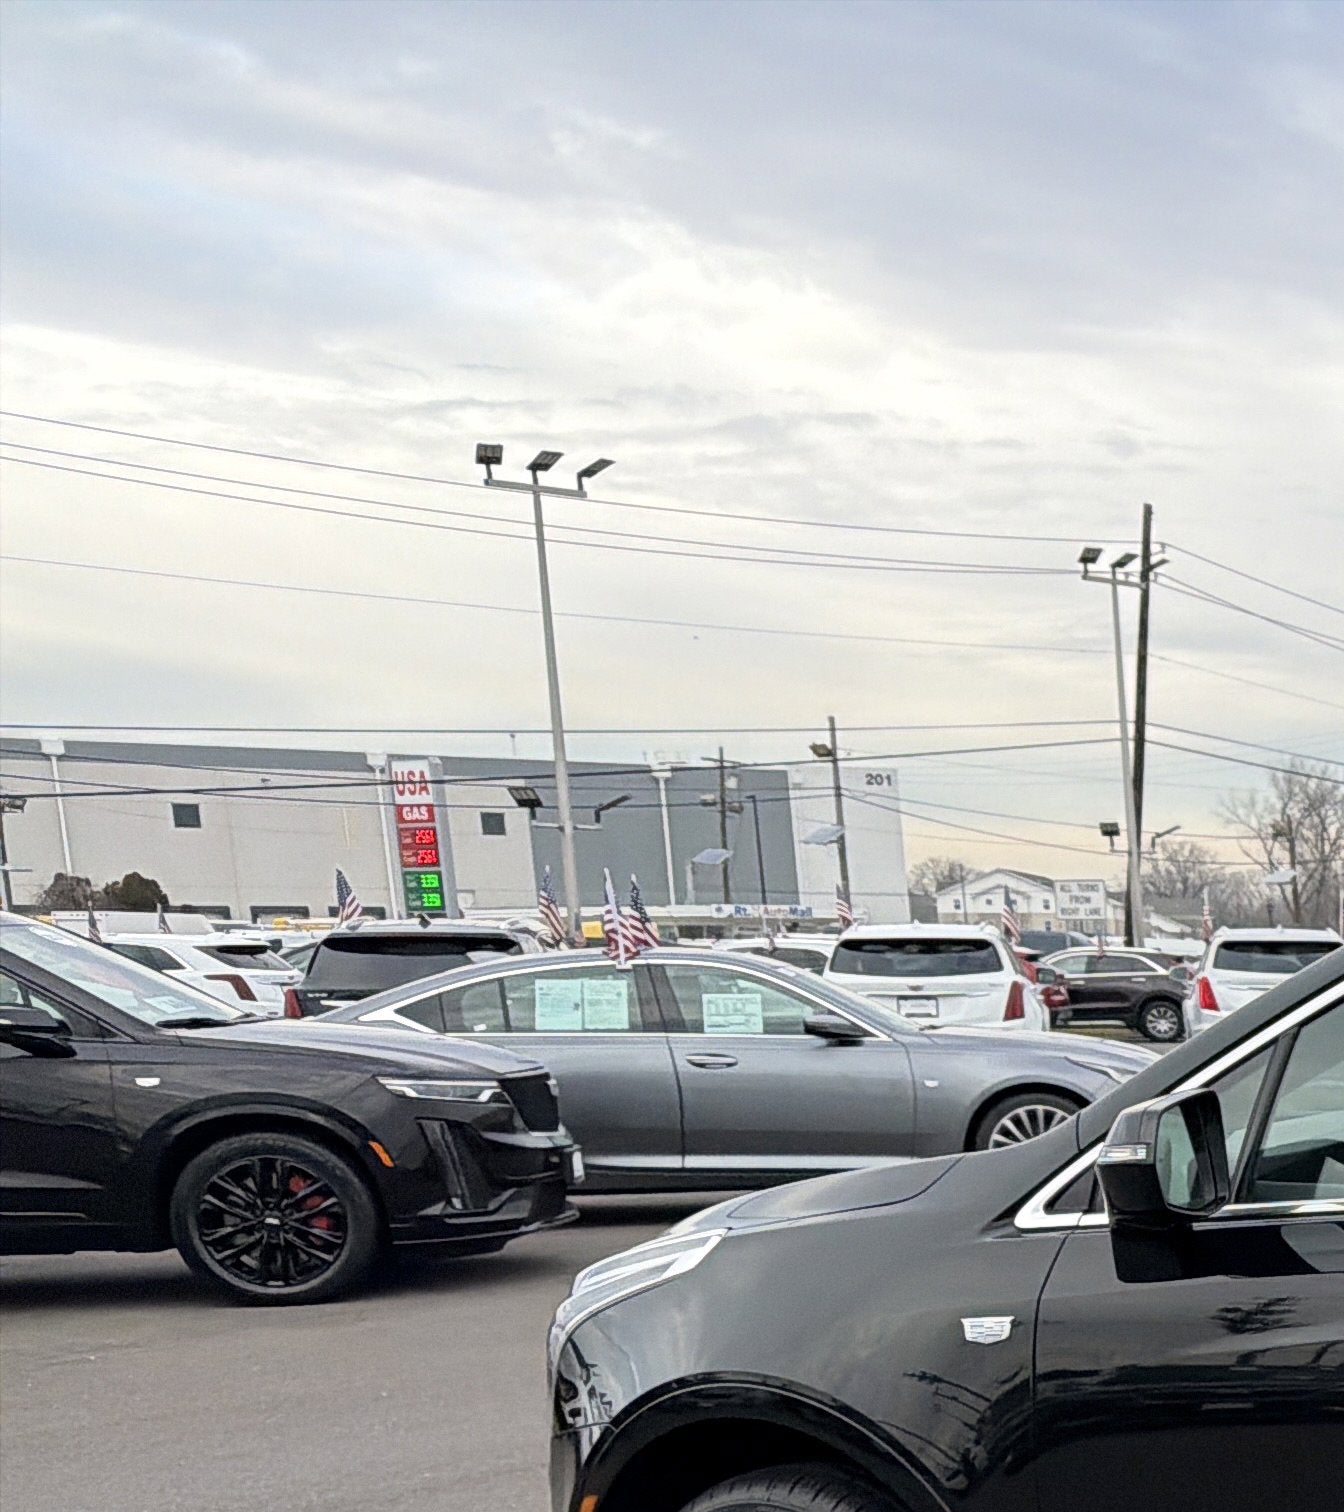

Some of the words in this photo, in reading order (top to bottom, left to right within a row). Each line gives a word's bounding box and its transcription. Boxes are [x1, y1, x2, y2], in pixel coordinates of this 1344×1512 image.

[394, 770, 431, 796] USA
[865, 773, 892, 786] 201
[402, 806, 429, 820] GAS
